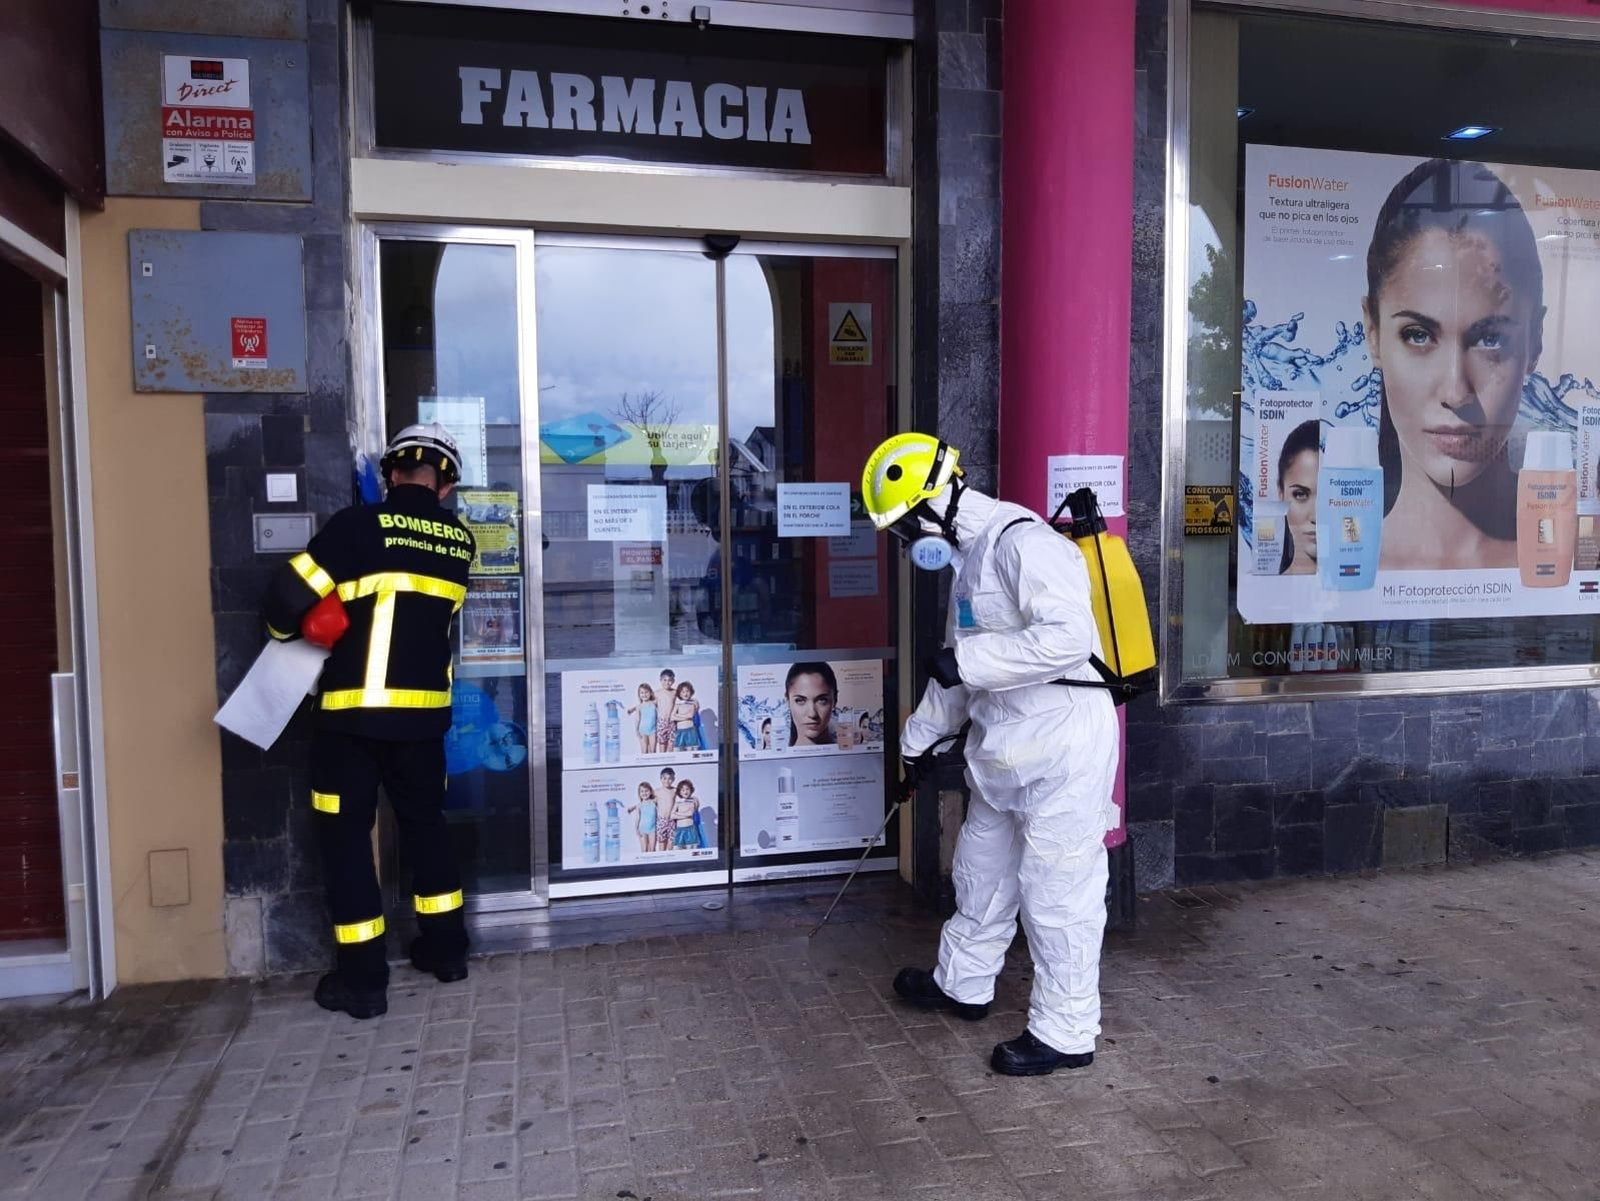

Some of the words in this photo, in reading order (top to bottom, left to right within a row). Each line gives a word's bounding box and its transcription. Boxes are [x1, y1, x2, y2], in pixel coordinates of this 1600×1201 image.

[177, 79, 240, 101] Direct
[459, 66, 812, 145] FARMACIA
[166, 110, 252, 130] Alarma
[185, 129, 211, 137] Aviso
[1268, 174, 1350, 192] FusionWater
[1269, 196, 1303, 208] Textura
[1305, 198, 1350, 211] ultraligera
[1259, 211, 1276, 221] que
[1278, 212, 1290, 220] no
[1292, 211, 1311, 222] pica
[1326, 212, 1339, 222] los
[1340, 214, 1359, 225] ojos
[1557, 216, 1596, 228] Cobertura
[1259, 399, 1314, 410] Fotoprotector
[1259, 409, 1285, 420] ISDIN
[1259, 424, 1269, 498] FusionWater
[1329, 478, 1374, 488] Fotoprotector
[1340, 487, 1363, 496] ISDIN
[378, 514, 472, 544] BOMBEROS
[1186, 526, 1233, 534] PROSEGUR
[385, 536, 433, 552] provincia
[435, 543, 447, 555] de
[1382, 586, 1396, 597] Mi
[1398, 583, 1480, 598] Fotoprotección
[1482, 582, 1513, 595] ISDIN
[1354, 647, 1392, 662] MILER
